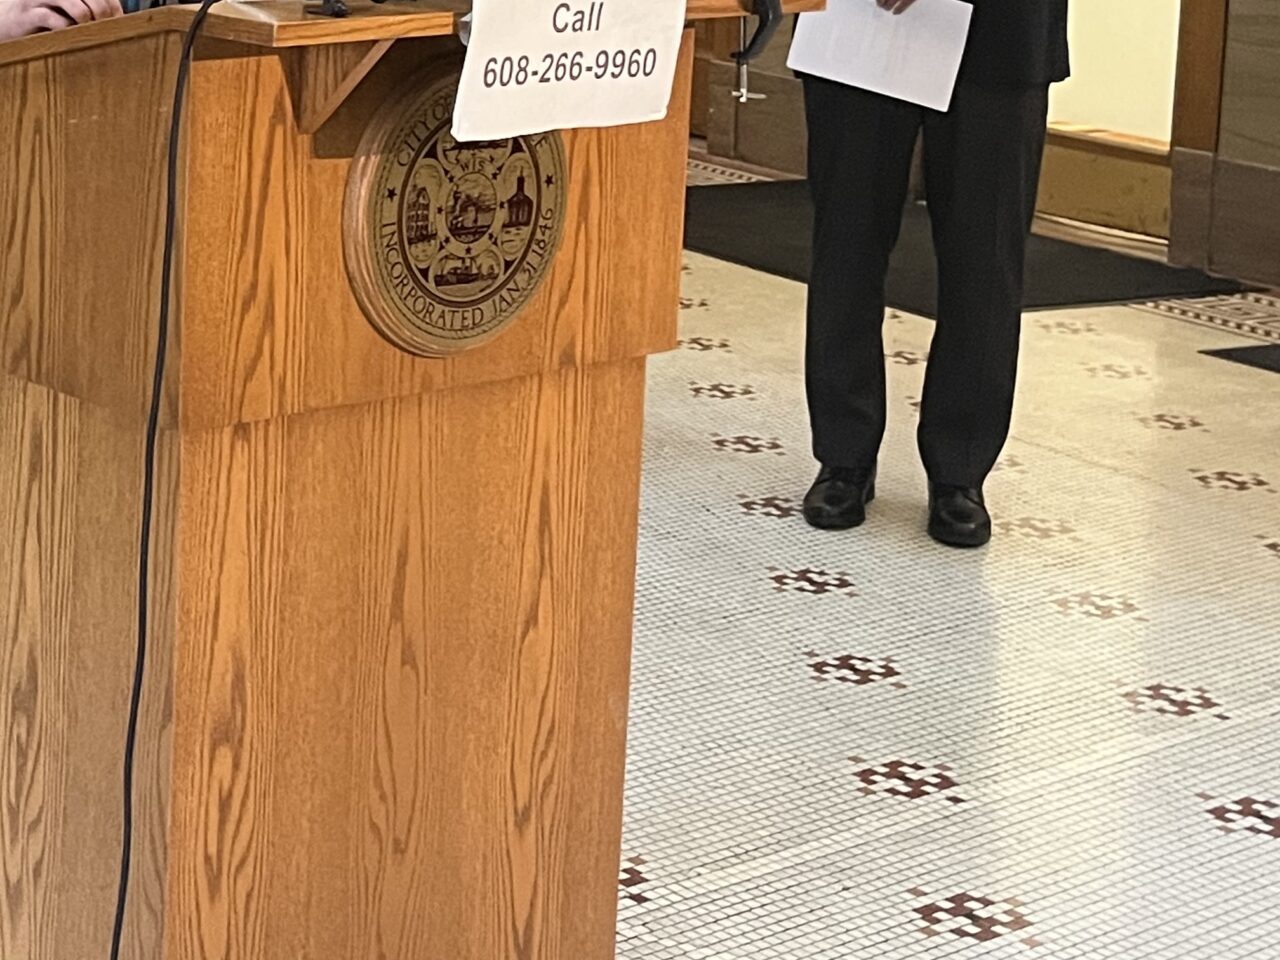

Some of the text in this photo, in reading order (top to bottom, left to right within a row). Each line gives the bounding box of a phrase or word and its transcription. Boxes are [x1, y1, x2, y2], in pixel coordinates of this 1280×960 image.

[552, 1, 604, 33] Call
[483, 47, 657, 89] 608-266-9960
[396, 110, 432, 167] CITY
[382, 222, 484, 329] INCORPORATED
[492, 281, 521, 315] JAN
[533, 207, 554, 259] 1846
